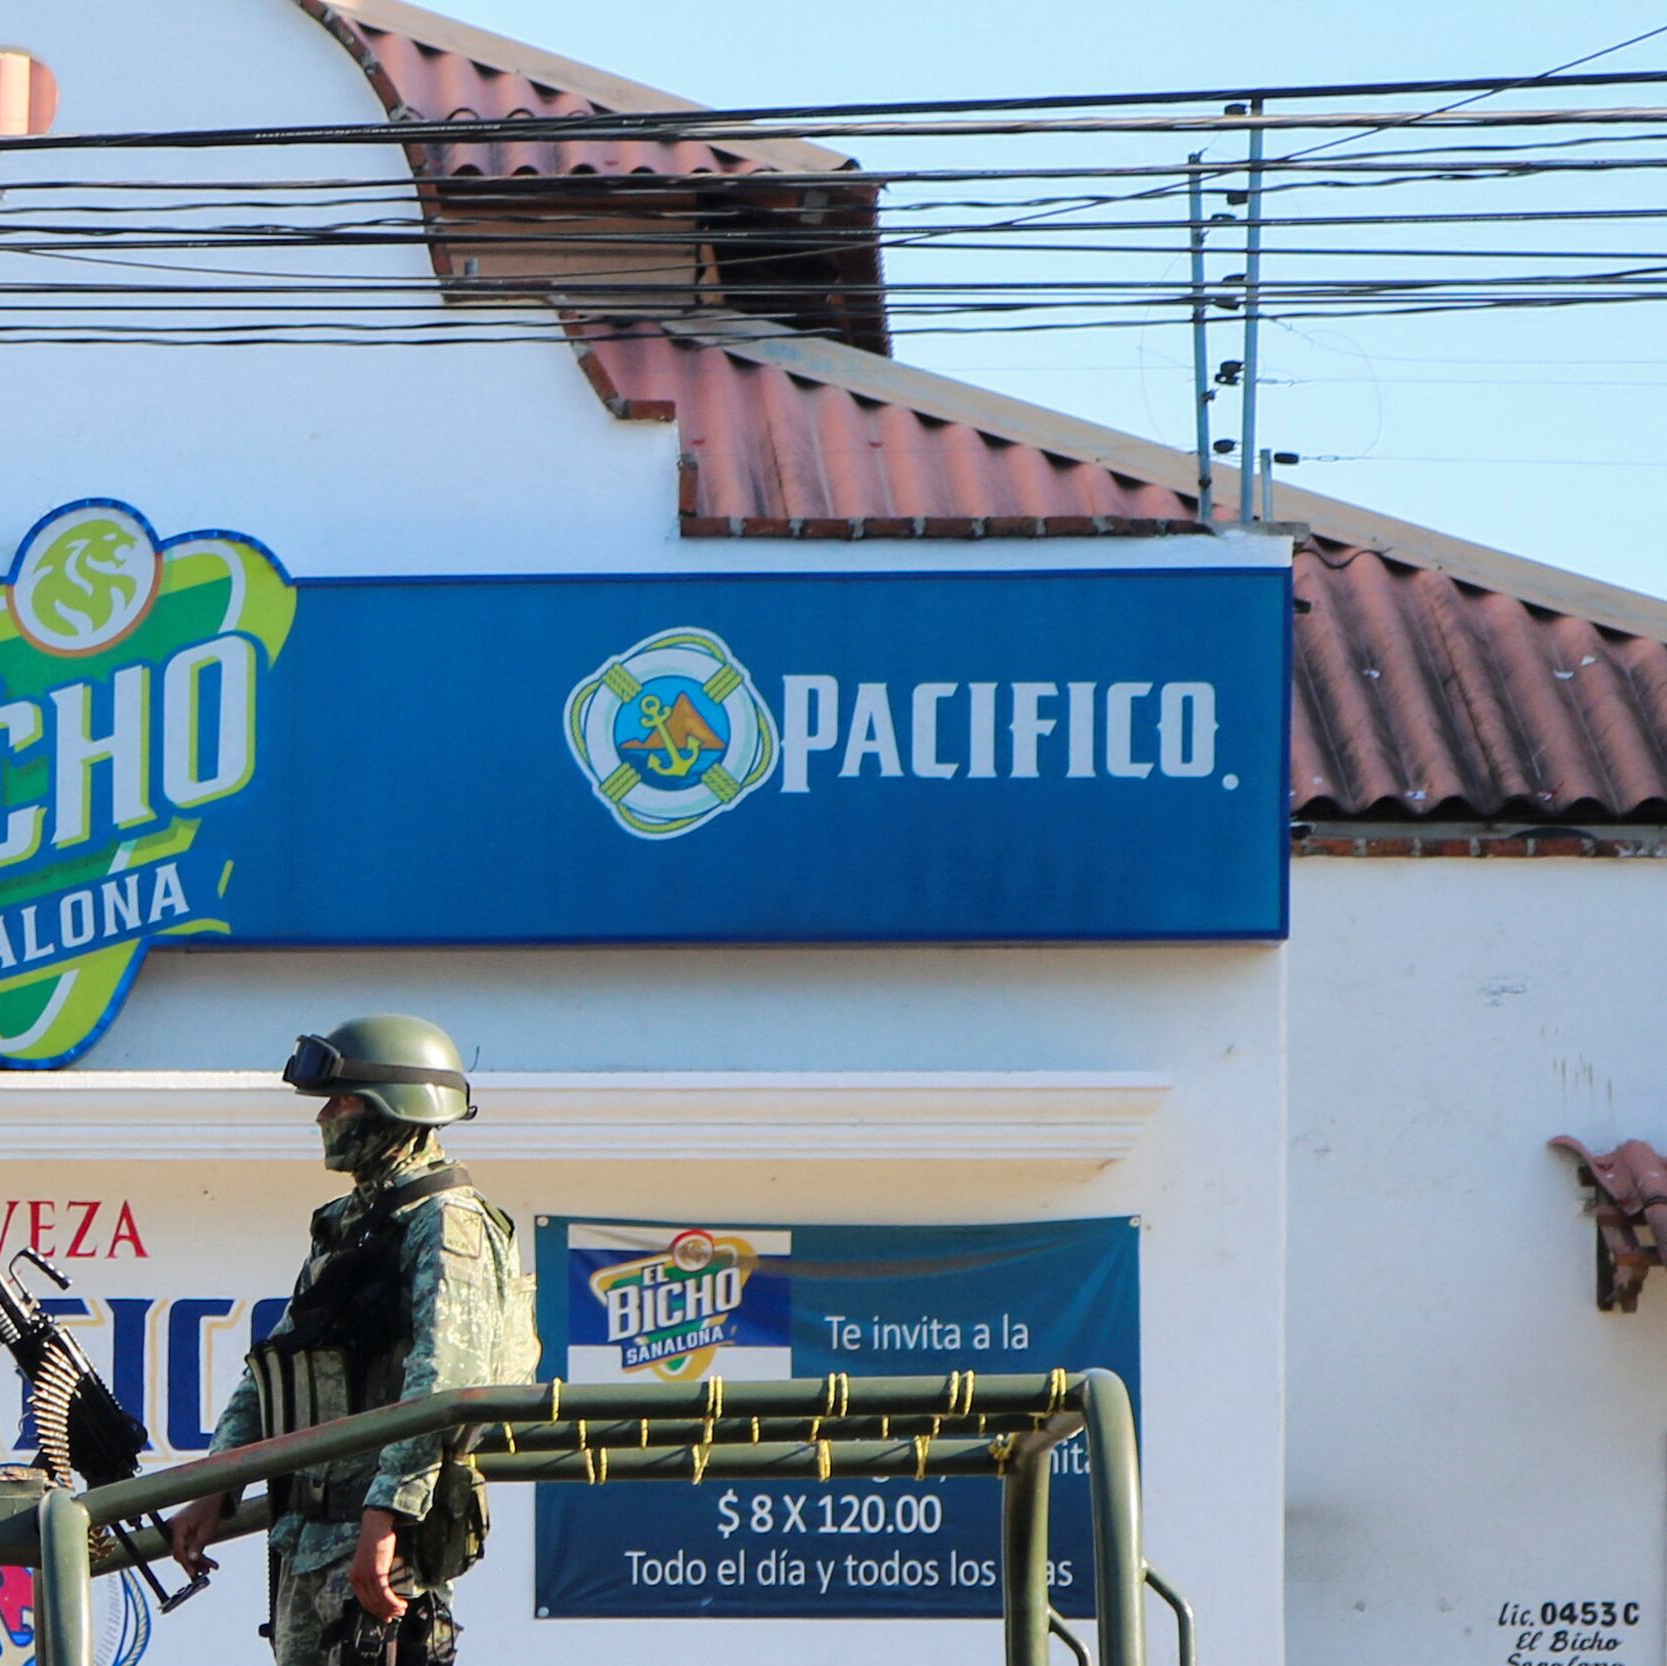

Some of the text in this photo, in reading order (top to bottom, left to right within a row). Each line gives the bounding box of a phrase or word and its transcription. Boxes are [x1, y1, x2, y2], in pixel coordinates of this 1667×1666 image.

[641, 1263, 670, 1286] EL
[606, 1267, 743, 1343] BICHO
[626, 1325, 725, 1365] SANALONA
[824, 1313, 1029, 1350] Te invita a la
[717, 1493, 943, 1539] $ 8 X 120.00
[624, 1550, 707, 1586] Todo
[717, 1549, 745, 1586] el
[756, 1549, 805, 1586] día
[816, 1558, 836, 1594] y
[845, 1549, 940, 1586] todos
[950, 1549, 996, 1586] los
[1516, 1630, 1623, 1652] El Bicho
